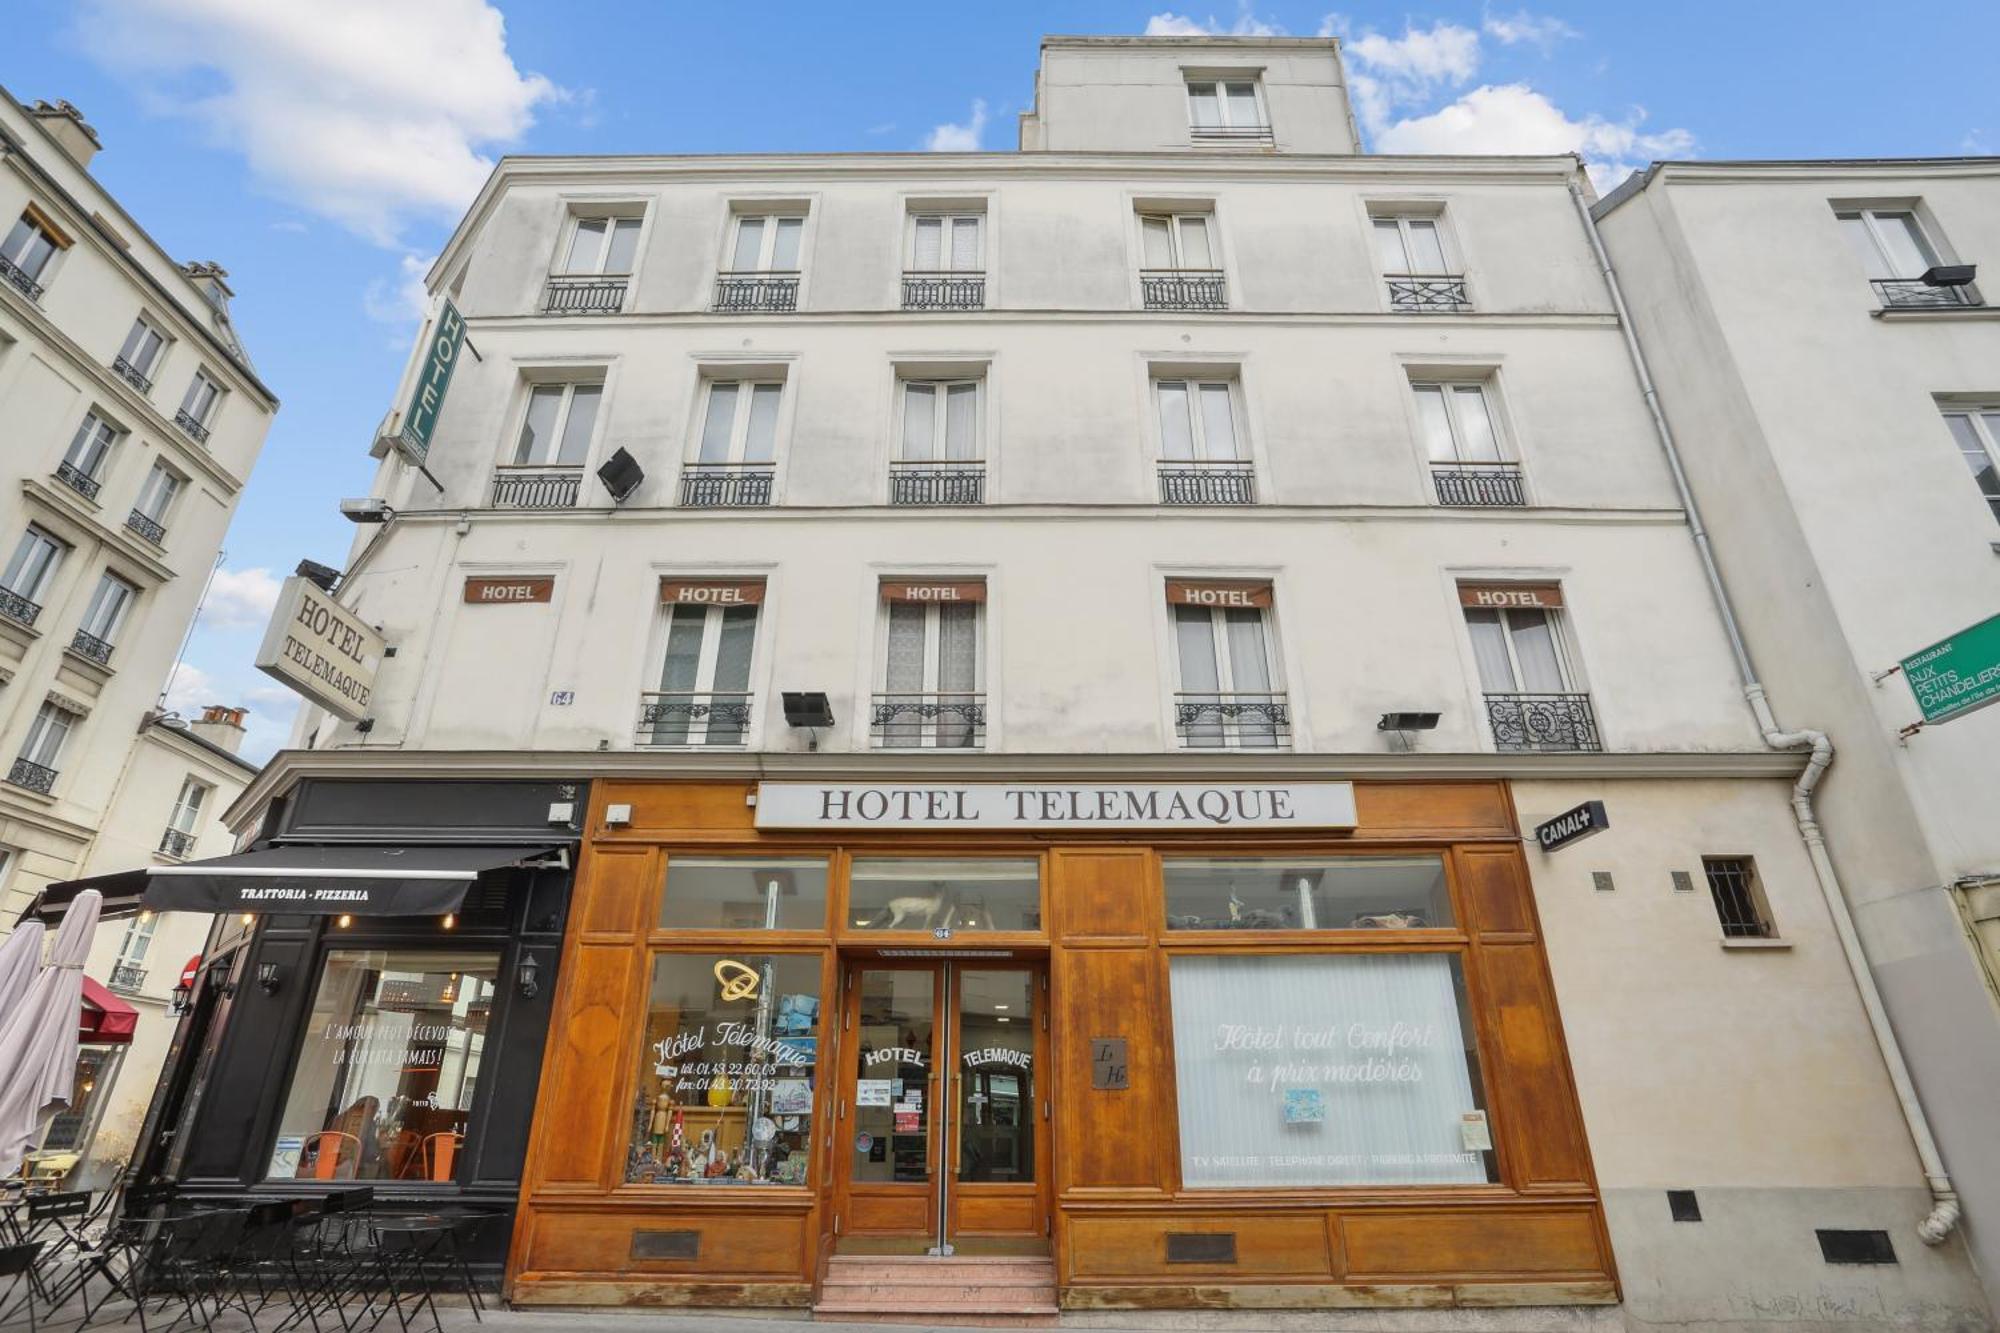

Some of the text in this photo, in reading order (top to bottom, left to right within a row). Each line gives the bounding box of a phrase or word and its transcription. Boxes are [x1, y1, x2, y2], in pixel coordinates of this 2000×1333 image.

[413, 310, 460, 438] HOTEL
[482, 586, 534, 600] HOTEL
[679, 587, 744, 602] HOTEL
[906, 587, 960, 600] HOTEL
[1185, 588, 1254, 606] HOTEL
[1477, 591, 1544, 605] HOTEL
[296, 595, 365, 664] HOTEL
[1905, 643, 1953, 670] RESTAURANT
[283, 635, 370, 706] TELEMAQUE
[1909, 665, 1937, 684] AUX
[1916, 670, 1958, 695] PETITS
[820, 790, 1295, 824] HOTEL TELEMAQUE
[1541, 809, 1590, 845] CANAL+
[240, 889, 306, 900] TRATTORIA
[314, 890, 369, 901] PIZZERIA
[1293, 1025, 1336, 1048] tout
[1347, 1023, 1433, 1056] Confort
[865, 1047, 925, 1067] HOTEL
[963, 1048, 1032, 1069] TELEMAQUE
[1270, 1058, 1319, 1092] prix
[1322, 1057, 1423, 1082] modérés
